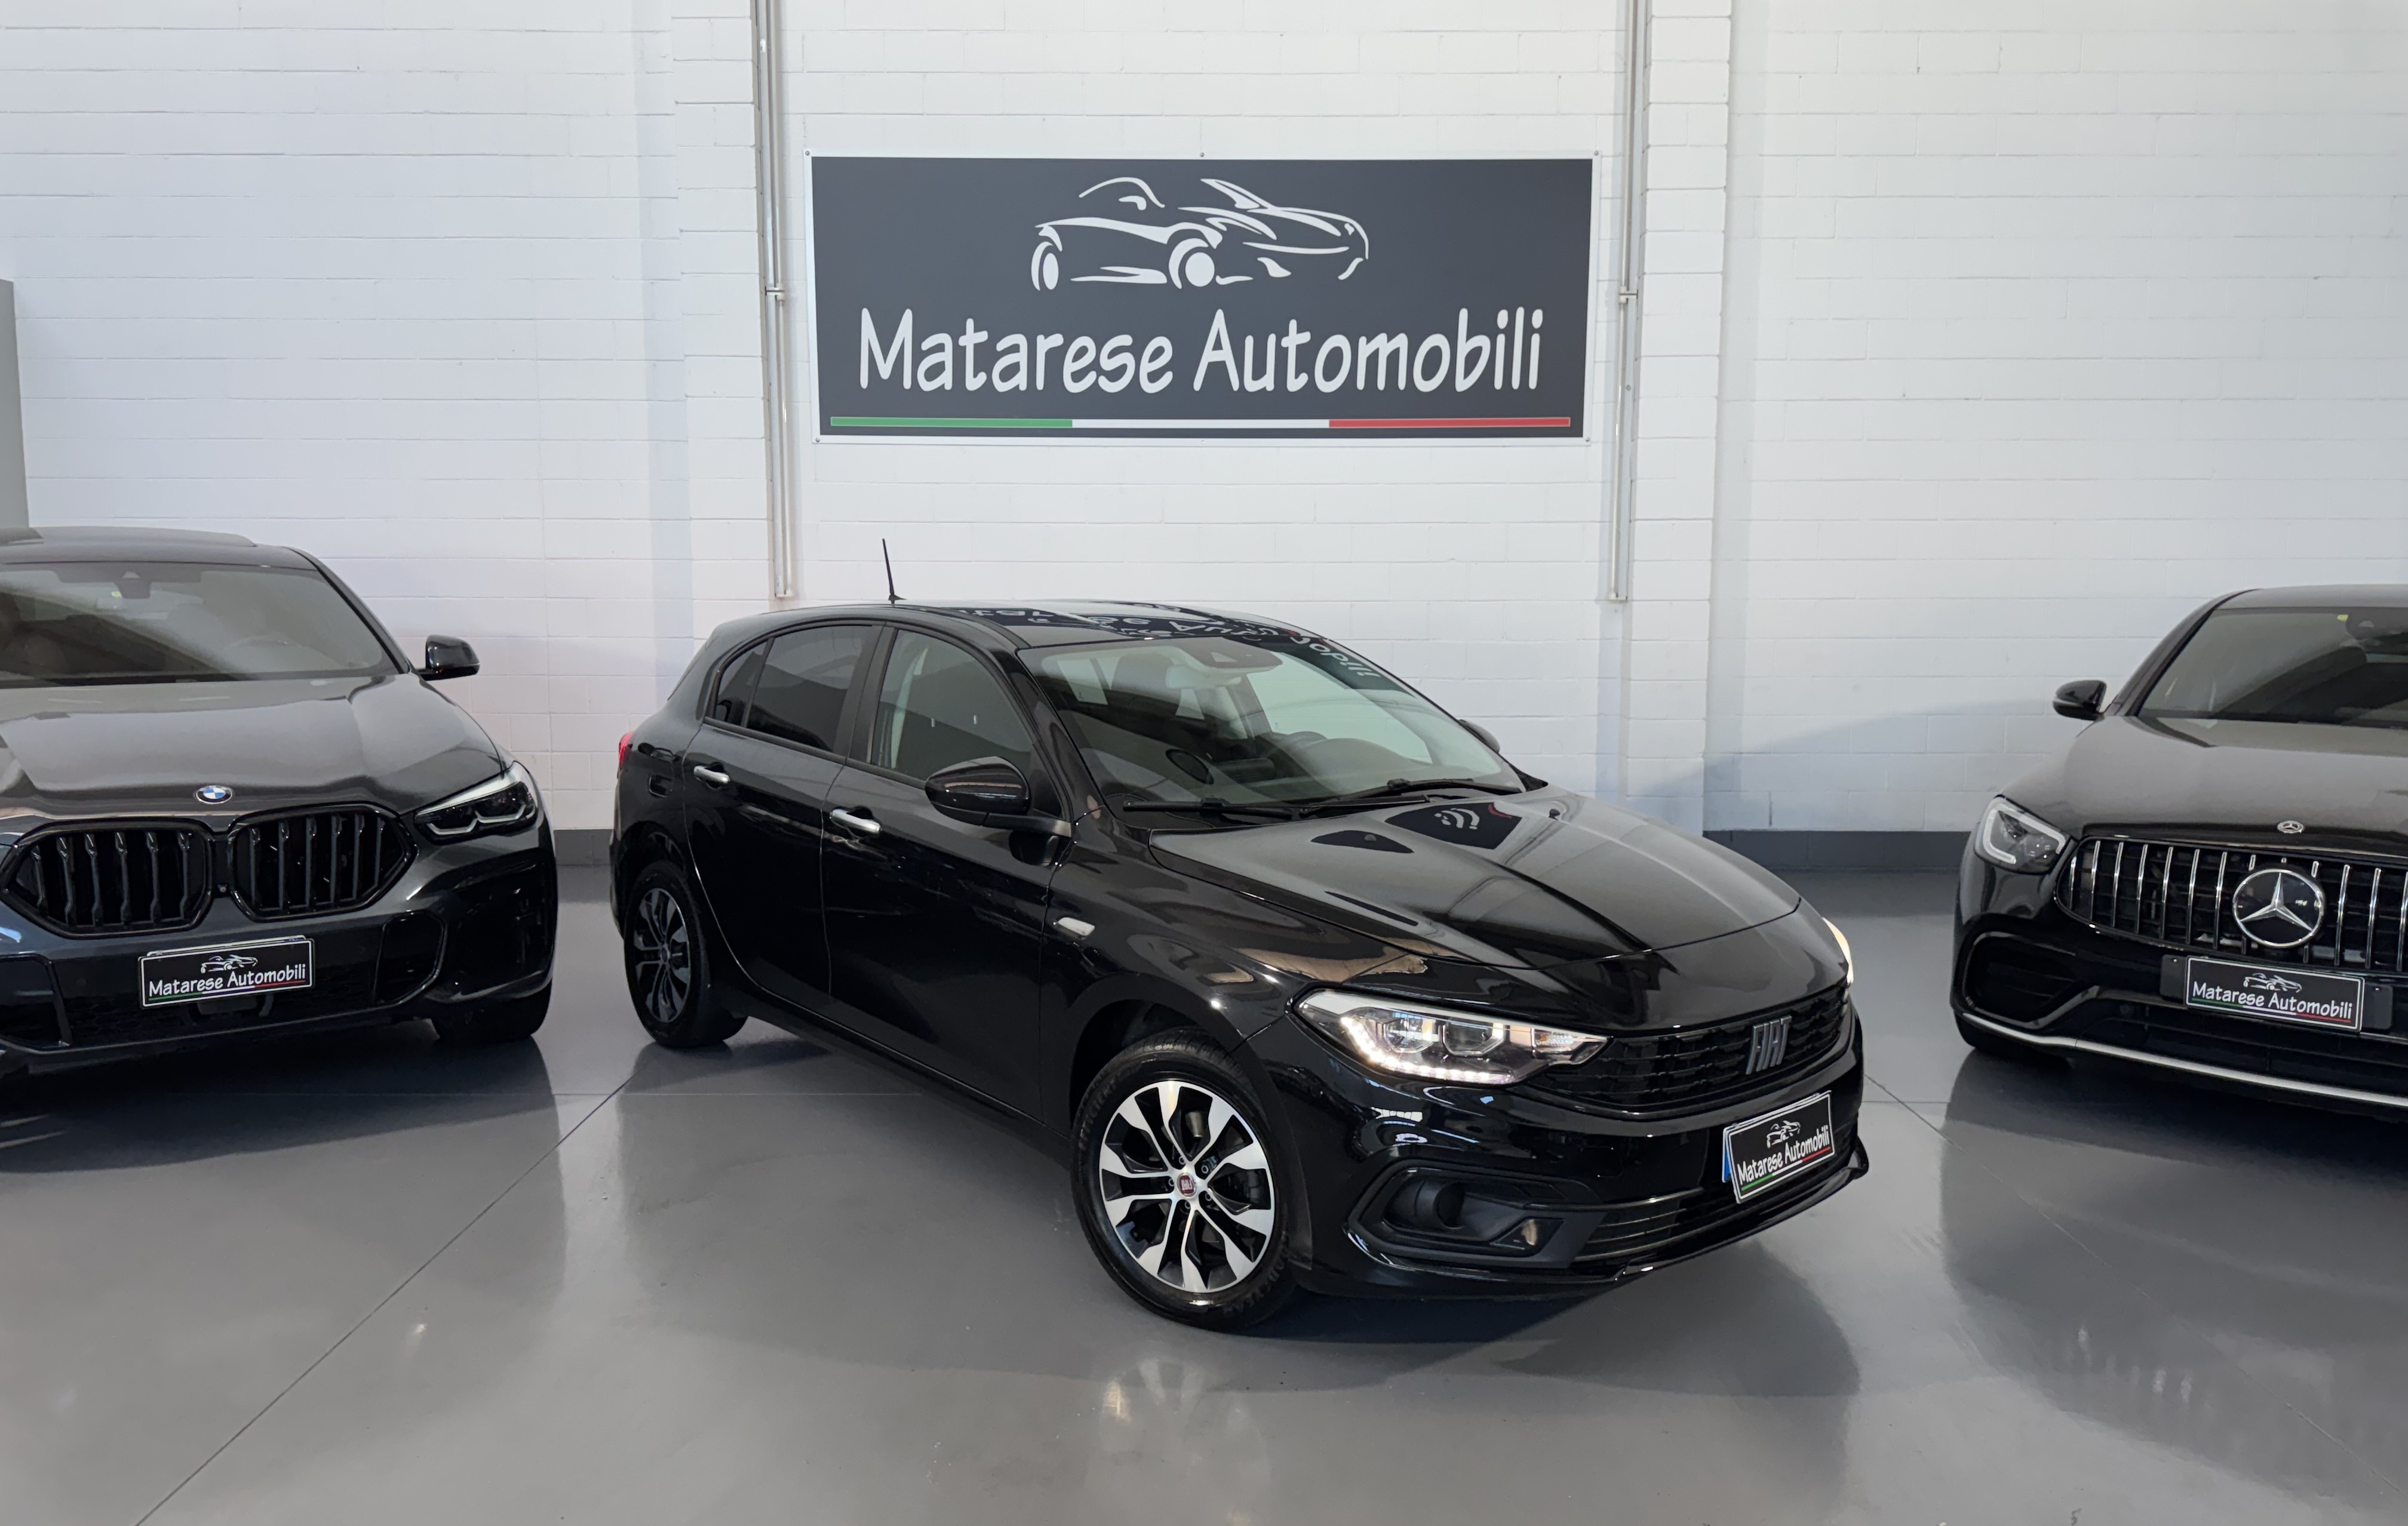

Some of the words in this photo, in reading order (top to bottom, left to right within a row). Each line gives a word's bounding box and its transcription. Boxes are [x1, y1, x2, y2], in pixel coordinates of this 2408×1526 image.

[859, 307, 1174, 393] Matarese
[1193, 306, 1543, 393] Automobili
[149, 977, 223, 997] Matarese
[227, 964, 306, 987] Automobili
[2192, 981, 2265, 1008] Matarese
[2268, 992, 2352, 1020] Automobili
[1746, 1016, 1792, 1075] FIAT
[1737, 1151, 1784, 1186] Matarese
[1784, 1124, 1830, 1165] Automobili
